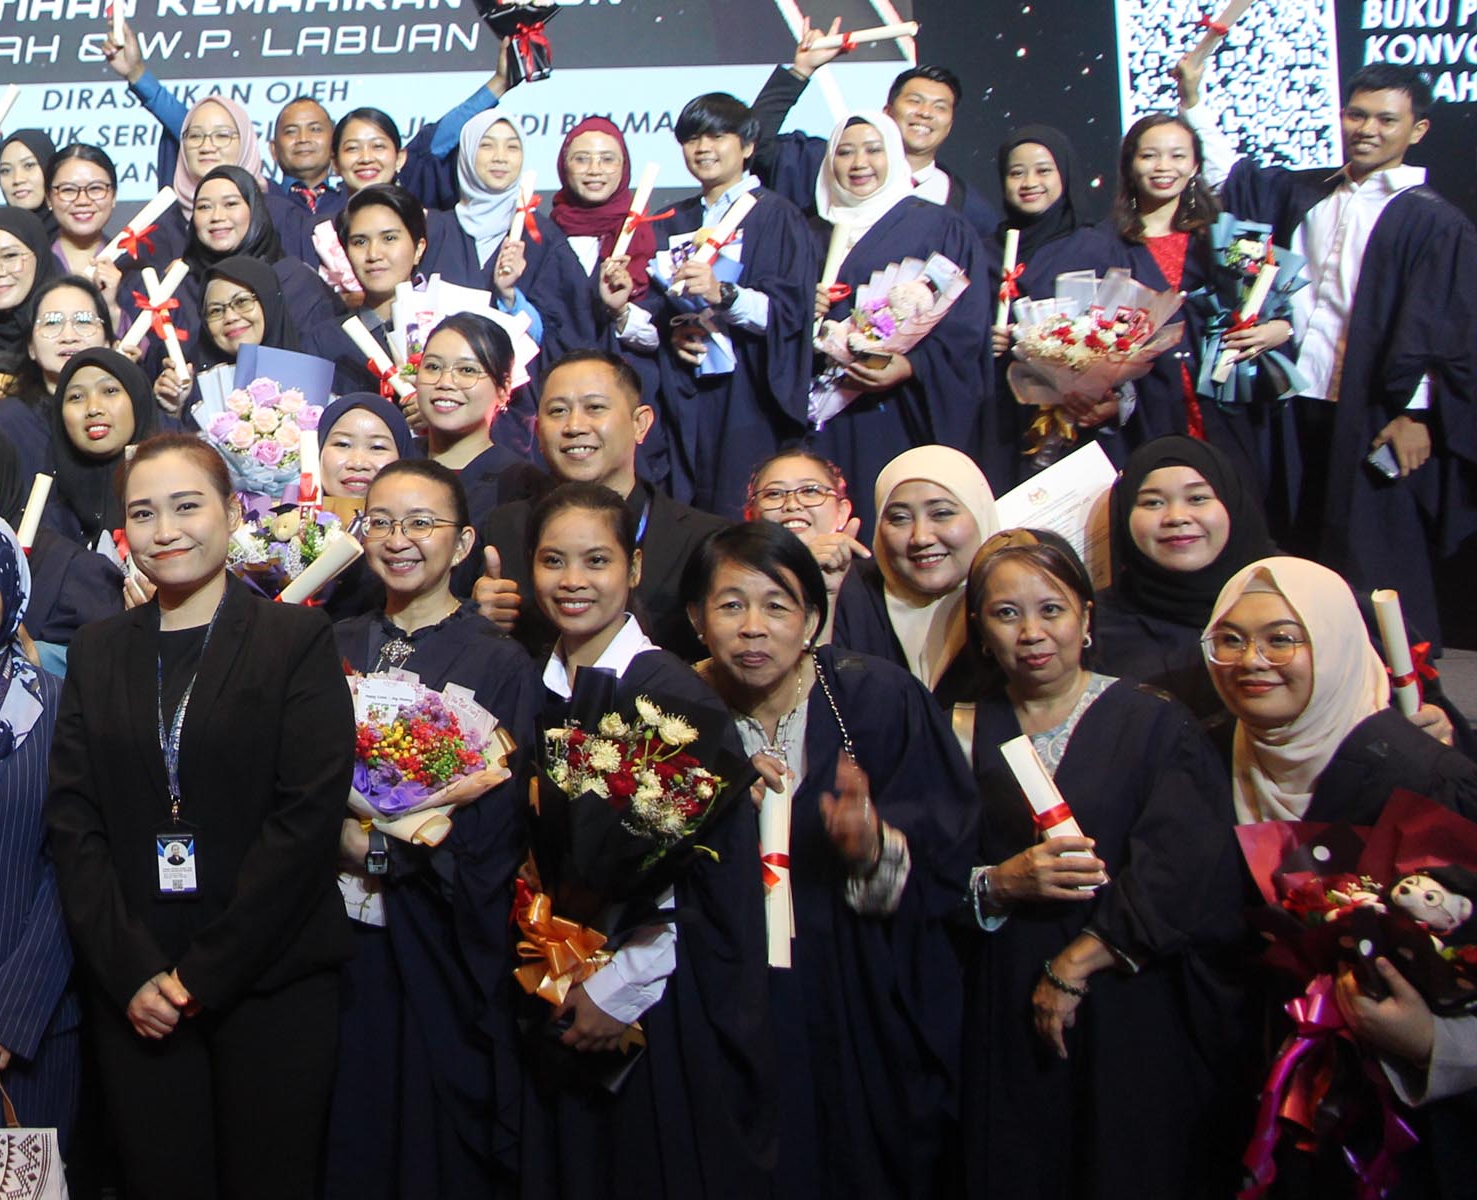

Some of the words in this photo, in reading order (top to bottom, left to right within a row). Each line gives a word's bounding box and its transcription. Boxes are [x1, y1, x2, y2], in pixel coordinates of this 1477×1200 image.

[1361, 0, 1451, 29] BUKU
[138, 29, 240, 60] W.P.
[261, 22, 480, 57] LABUAN
[265, 80, 350, 104] OLEH
[95, 124, 158, 148] SERI
